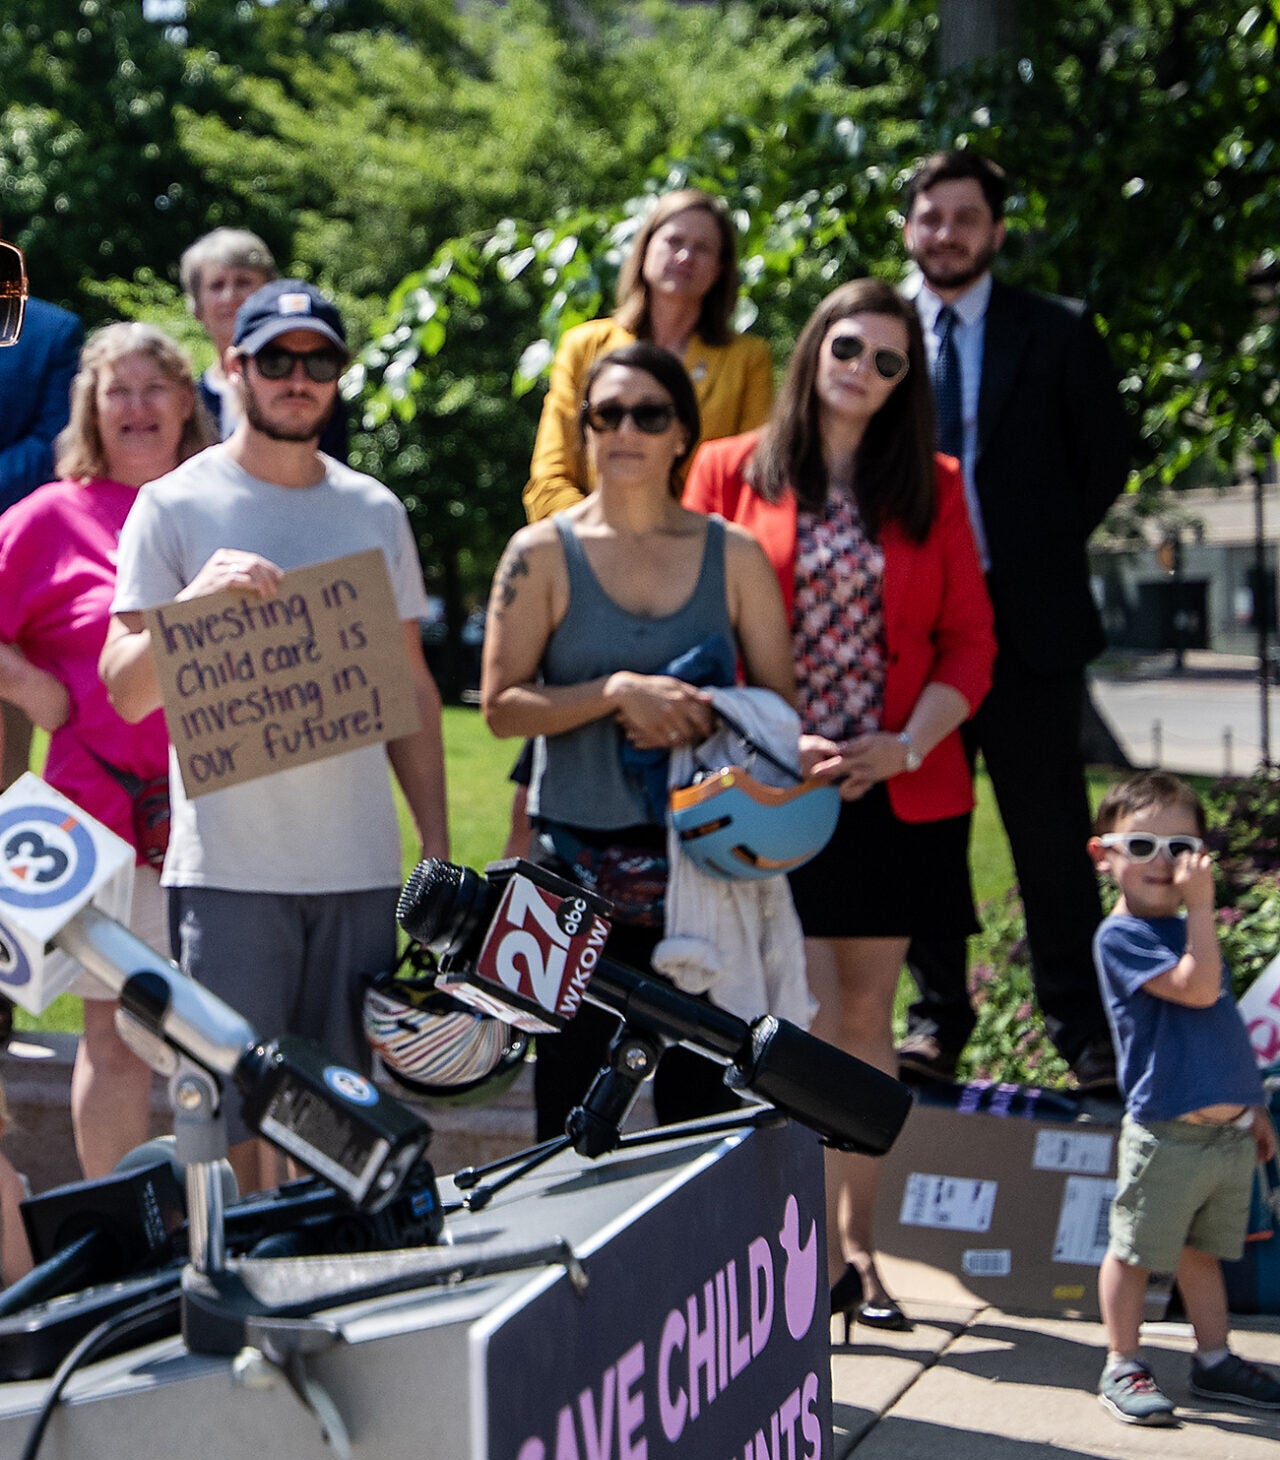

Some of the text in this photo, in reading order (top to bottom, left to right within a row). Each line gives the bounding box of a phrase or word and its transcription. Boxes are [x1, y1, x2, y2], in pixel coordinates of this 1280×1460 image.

[156, 579, 357, 654] Investing in
[261, 636, 321, 674] care
[337, 620, 368, 650] is
[181, 664, 368, 740] investing in
[188, 687, 384, 784] our future!
[5, 831, 68, 883] 3
[496, 873, 570, 1014] 27
[564, 898, 587, 936] abc
[560, 918, 609, 1013] WKOW
[517, 1235, 774, 1460] VE CHILD
